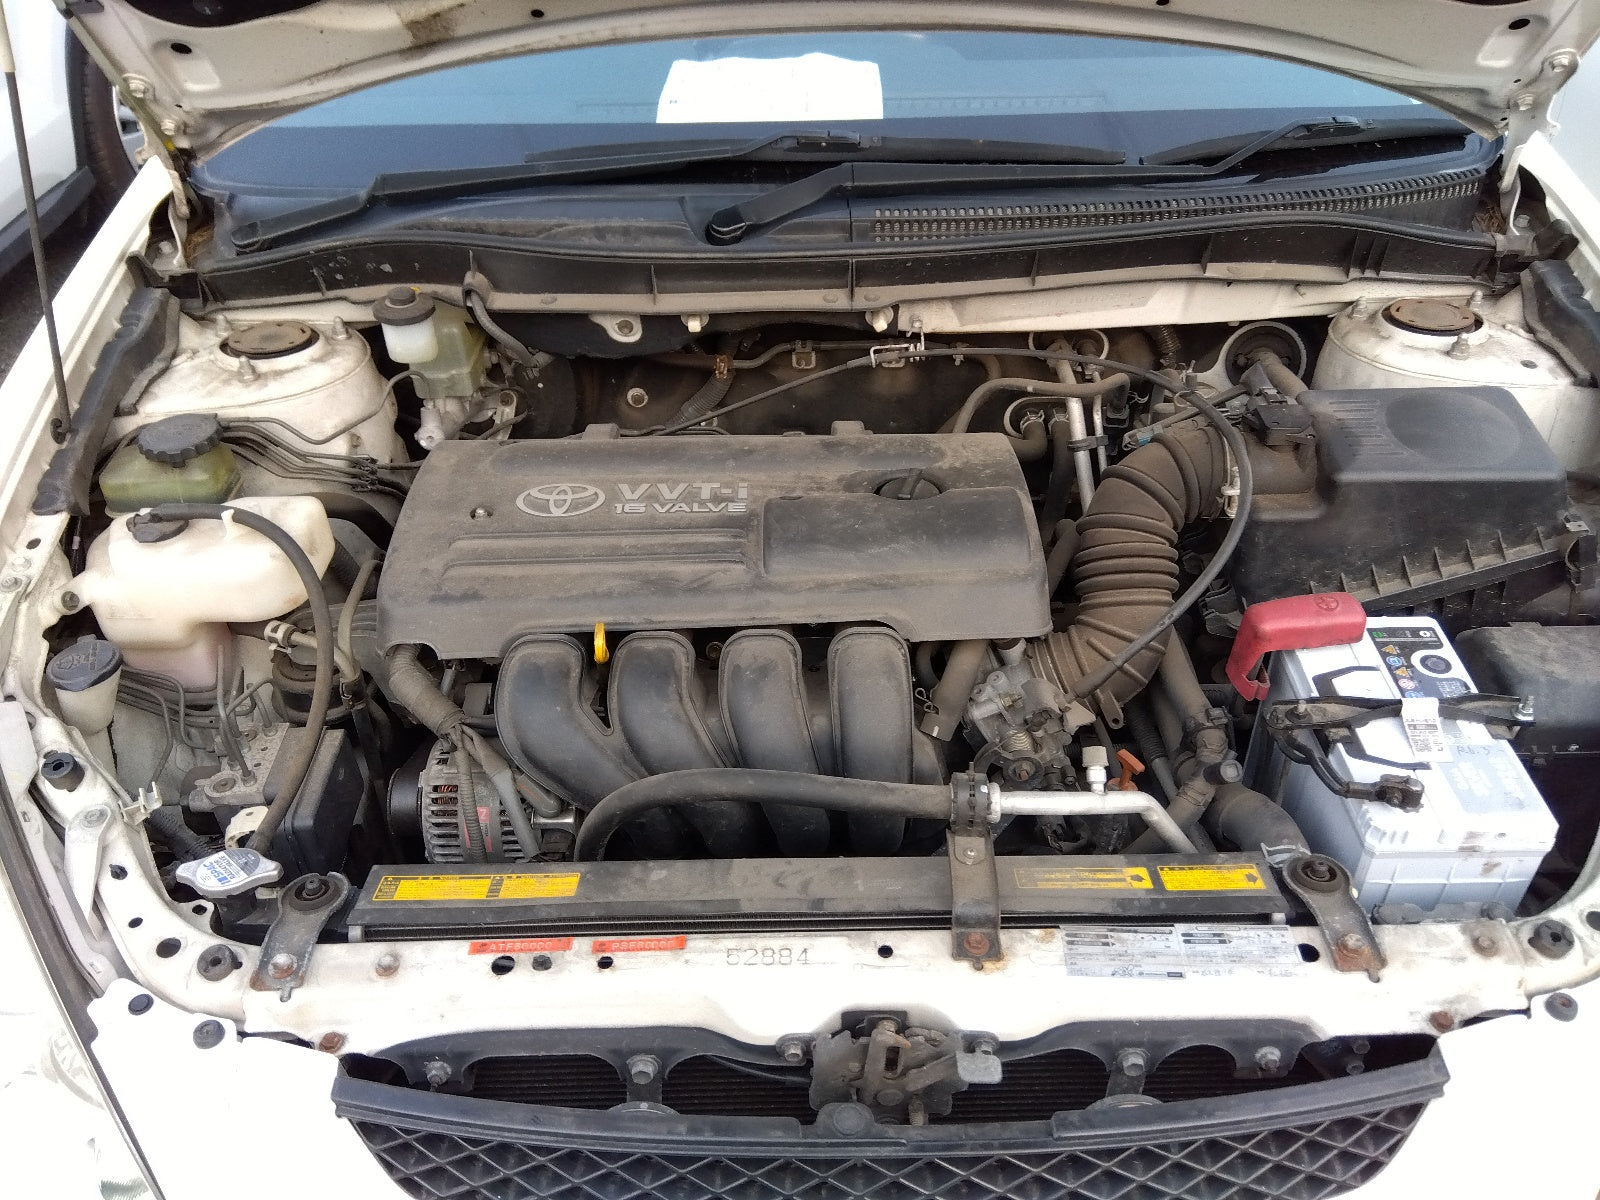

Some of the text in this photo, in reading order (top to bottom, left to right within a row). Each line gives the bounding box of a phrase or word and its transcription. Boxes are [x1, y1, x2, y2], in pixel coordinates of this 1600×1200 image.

[617, 482, 749, 501] VVT-i
[614, 502, 748, 514] 16 VALVE
[726, 947, 810, 966] 52884
